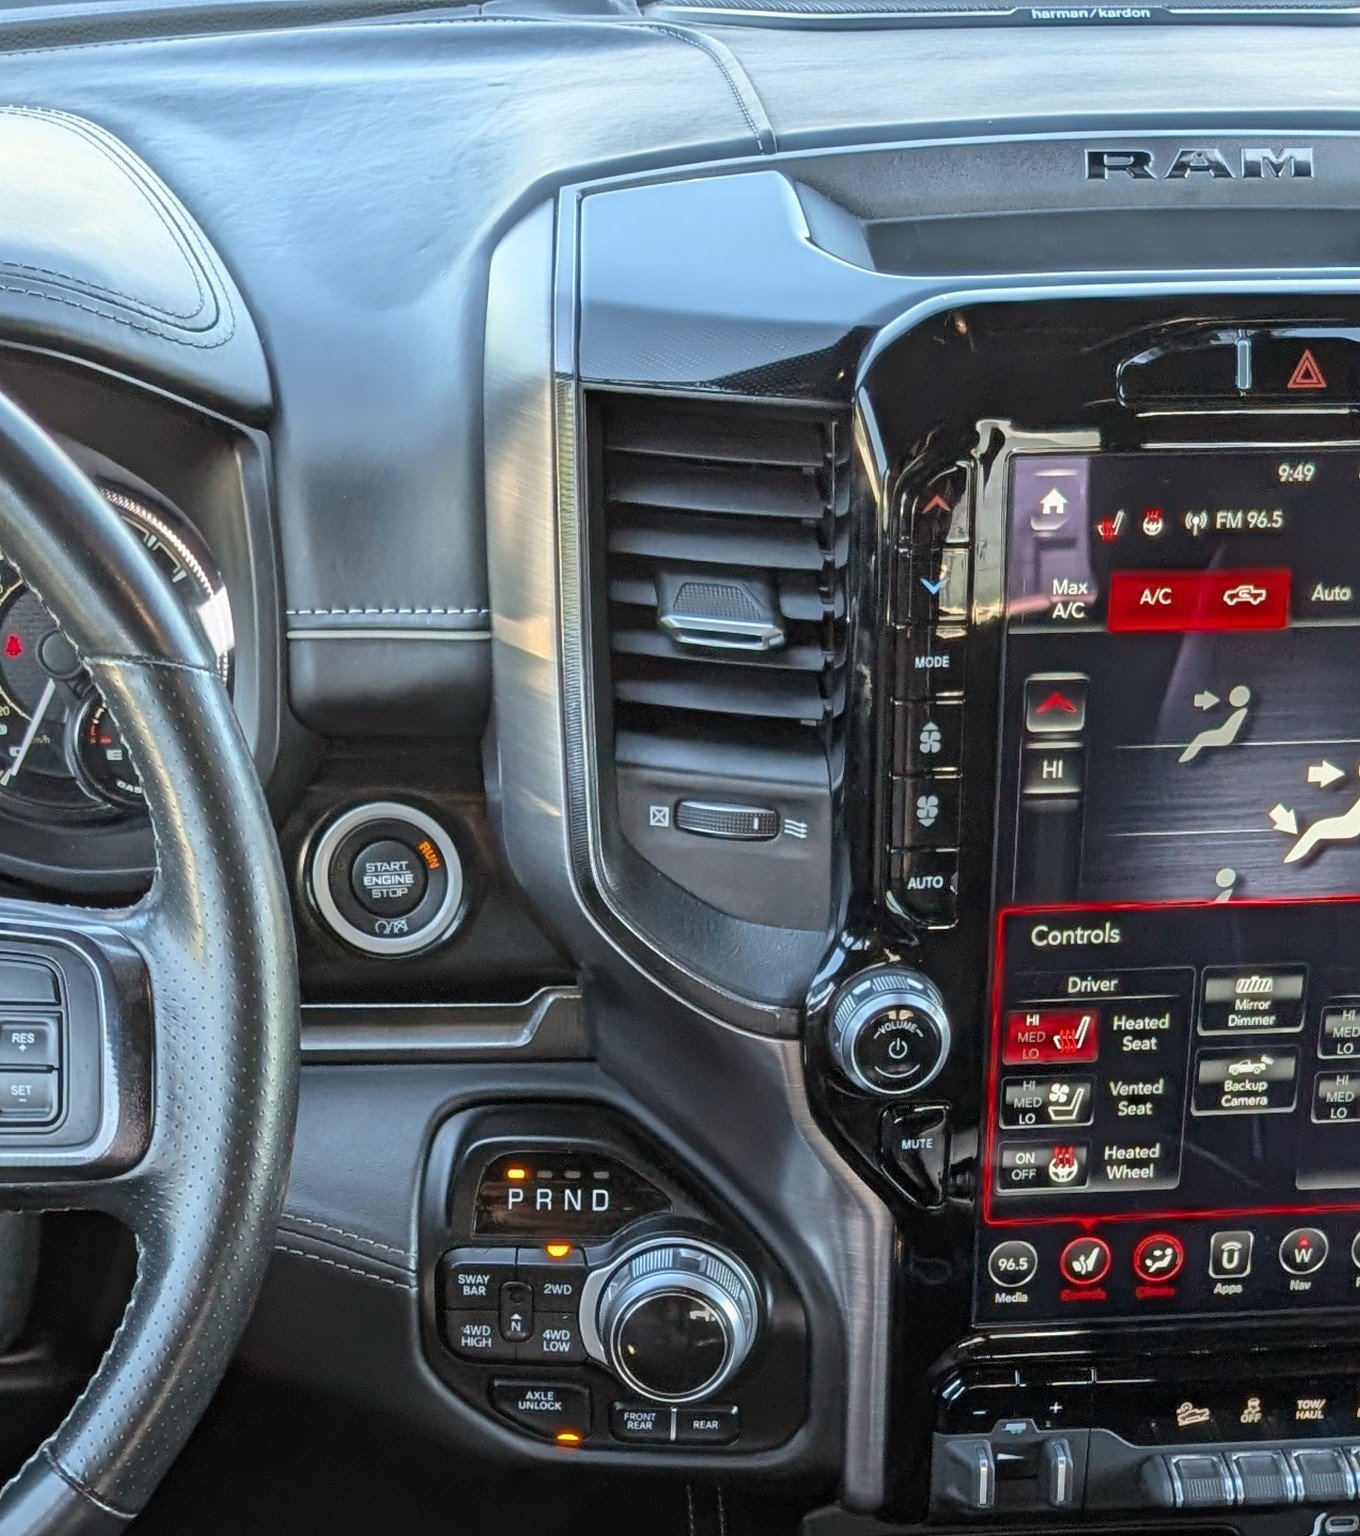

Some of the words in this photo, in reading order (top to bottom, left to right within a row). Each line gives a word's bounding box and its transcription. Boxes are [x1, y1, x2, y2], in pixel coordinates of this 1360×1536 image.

[1031, 8, 1151, 19] harman/kardon
[1083, 147, 1316, 182] RAM
[1278, 463, 1314, 481] 9:49
[1216, 512, 1242, 528] FM
[1247, 511, 1282, 528] 96.5
[1052, 578, 1087, 594] Max
[1140, 588, 1172, 605] A/C
[1311, 584, 1351, 602] Auto
[1052, 601, 1086, 618] A/C
[914, 656, 949, 668] MODE
[1042, 759, 1063, 778] HI
[418, 840, 441, 870] RUN
[365, 860, 408, 872] START
[363, 873, 414, 886] ENGINE
[907, 876, 943, 889] AUTO
[371, 887, 408, 899] STOP
[1031, 921, 1122, 947] Controls
[1067, 975, 1118, 992] Driver
[1234, 999, 1271, 1011] Mirror
[1025, 1013, 1039, 1026] HI
[1113, 1013, 1170, 1030] Heated
[1228, 1014, 1276, 1026] Dimmer
[1342, 1010, 1355, 1021] HI
[878, 1020, 917, 1034] VOLUME
[1332, 1027, 1360, 1039] MED
[11, 1032, 35, 1044] RES
[1017, 1031, 1046, 1043] MED
[1122, 1035, 1157, 1051] Seat
[1022, 1048, 1039, 1060] LO
[1336, 1043, 1354, 1055] LO
[1022, 1080, 1036, 1092] HI
[1109, 1077, 1164, 1096] Vented
[1224, 1079, 1268, 1092] Backup
[1336, 1075, 1349, 1086] HI
[11, 1085, 32, 1097] SET
[1326, 1091, 1354, 1103] MED
[1013, 1097, 1042, 1109] MED
[1221, 1095, 1268, 1107] Camera
[1117, 1101, 1152, 1116] Seat
[1330, 1107, 1347, 1119] LO
[1018, 1113, 1035, 1125] LO
[901, 1138, 932, 1150] MUTE
[1104, 1143, 1160, 1160] Heated
[1015, 1152, 1035, 1164] ON
[1011, 1169, 1036, 1181] OFF
[1106, 1163, 1153, 1179] Wheel
[508, 1188, 524, 1210] P
[536, 1188, 553, 1211] R
[564, 1188, 582, 1211] N
[591, 1189, 609, 1212] D
[1295, 1248, 1312, 1263] W
[997, 1257, 1028, 1270] 96.5
[457, 1273, 489, 1285] SWAY
[1290, 1279, 1311, 1291] Nav
[463, 1286, 486, 1296] BAR
[543, 1283, 572, 1295] 2WD
[1061, 1288, 1105, 1300] Controls
[1135, 1286, 1175, 1298] Climate
[1213, 1282, 1242, 1295] Apps
[994, 1291, 1028, 1303] Media
[462, 1324, 490, 1336] 4WD
[510, 1321, 520, 1332] N
[542, 1329, 570, 1340] 4WD
[461, 1336, 491, 1348] HIGH
[543, 1341, 570, 1352] LOW
[525, 1391, 554, 1401] AXLE
[518, 1401, 562, 1411] UNLOCK
[1296, 1399, 1326, 1410] TOW/
[624, 1412, 656, 1422] FRONT
[1240, 1412, 1261, 1424] OFF
[1295, 1410, 1324, 1420] HAUL
[626, 1421, 653, 1430] REAR
[693, 1420, 718, 1430] REAR
